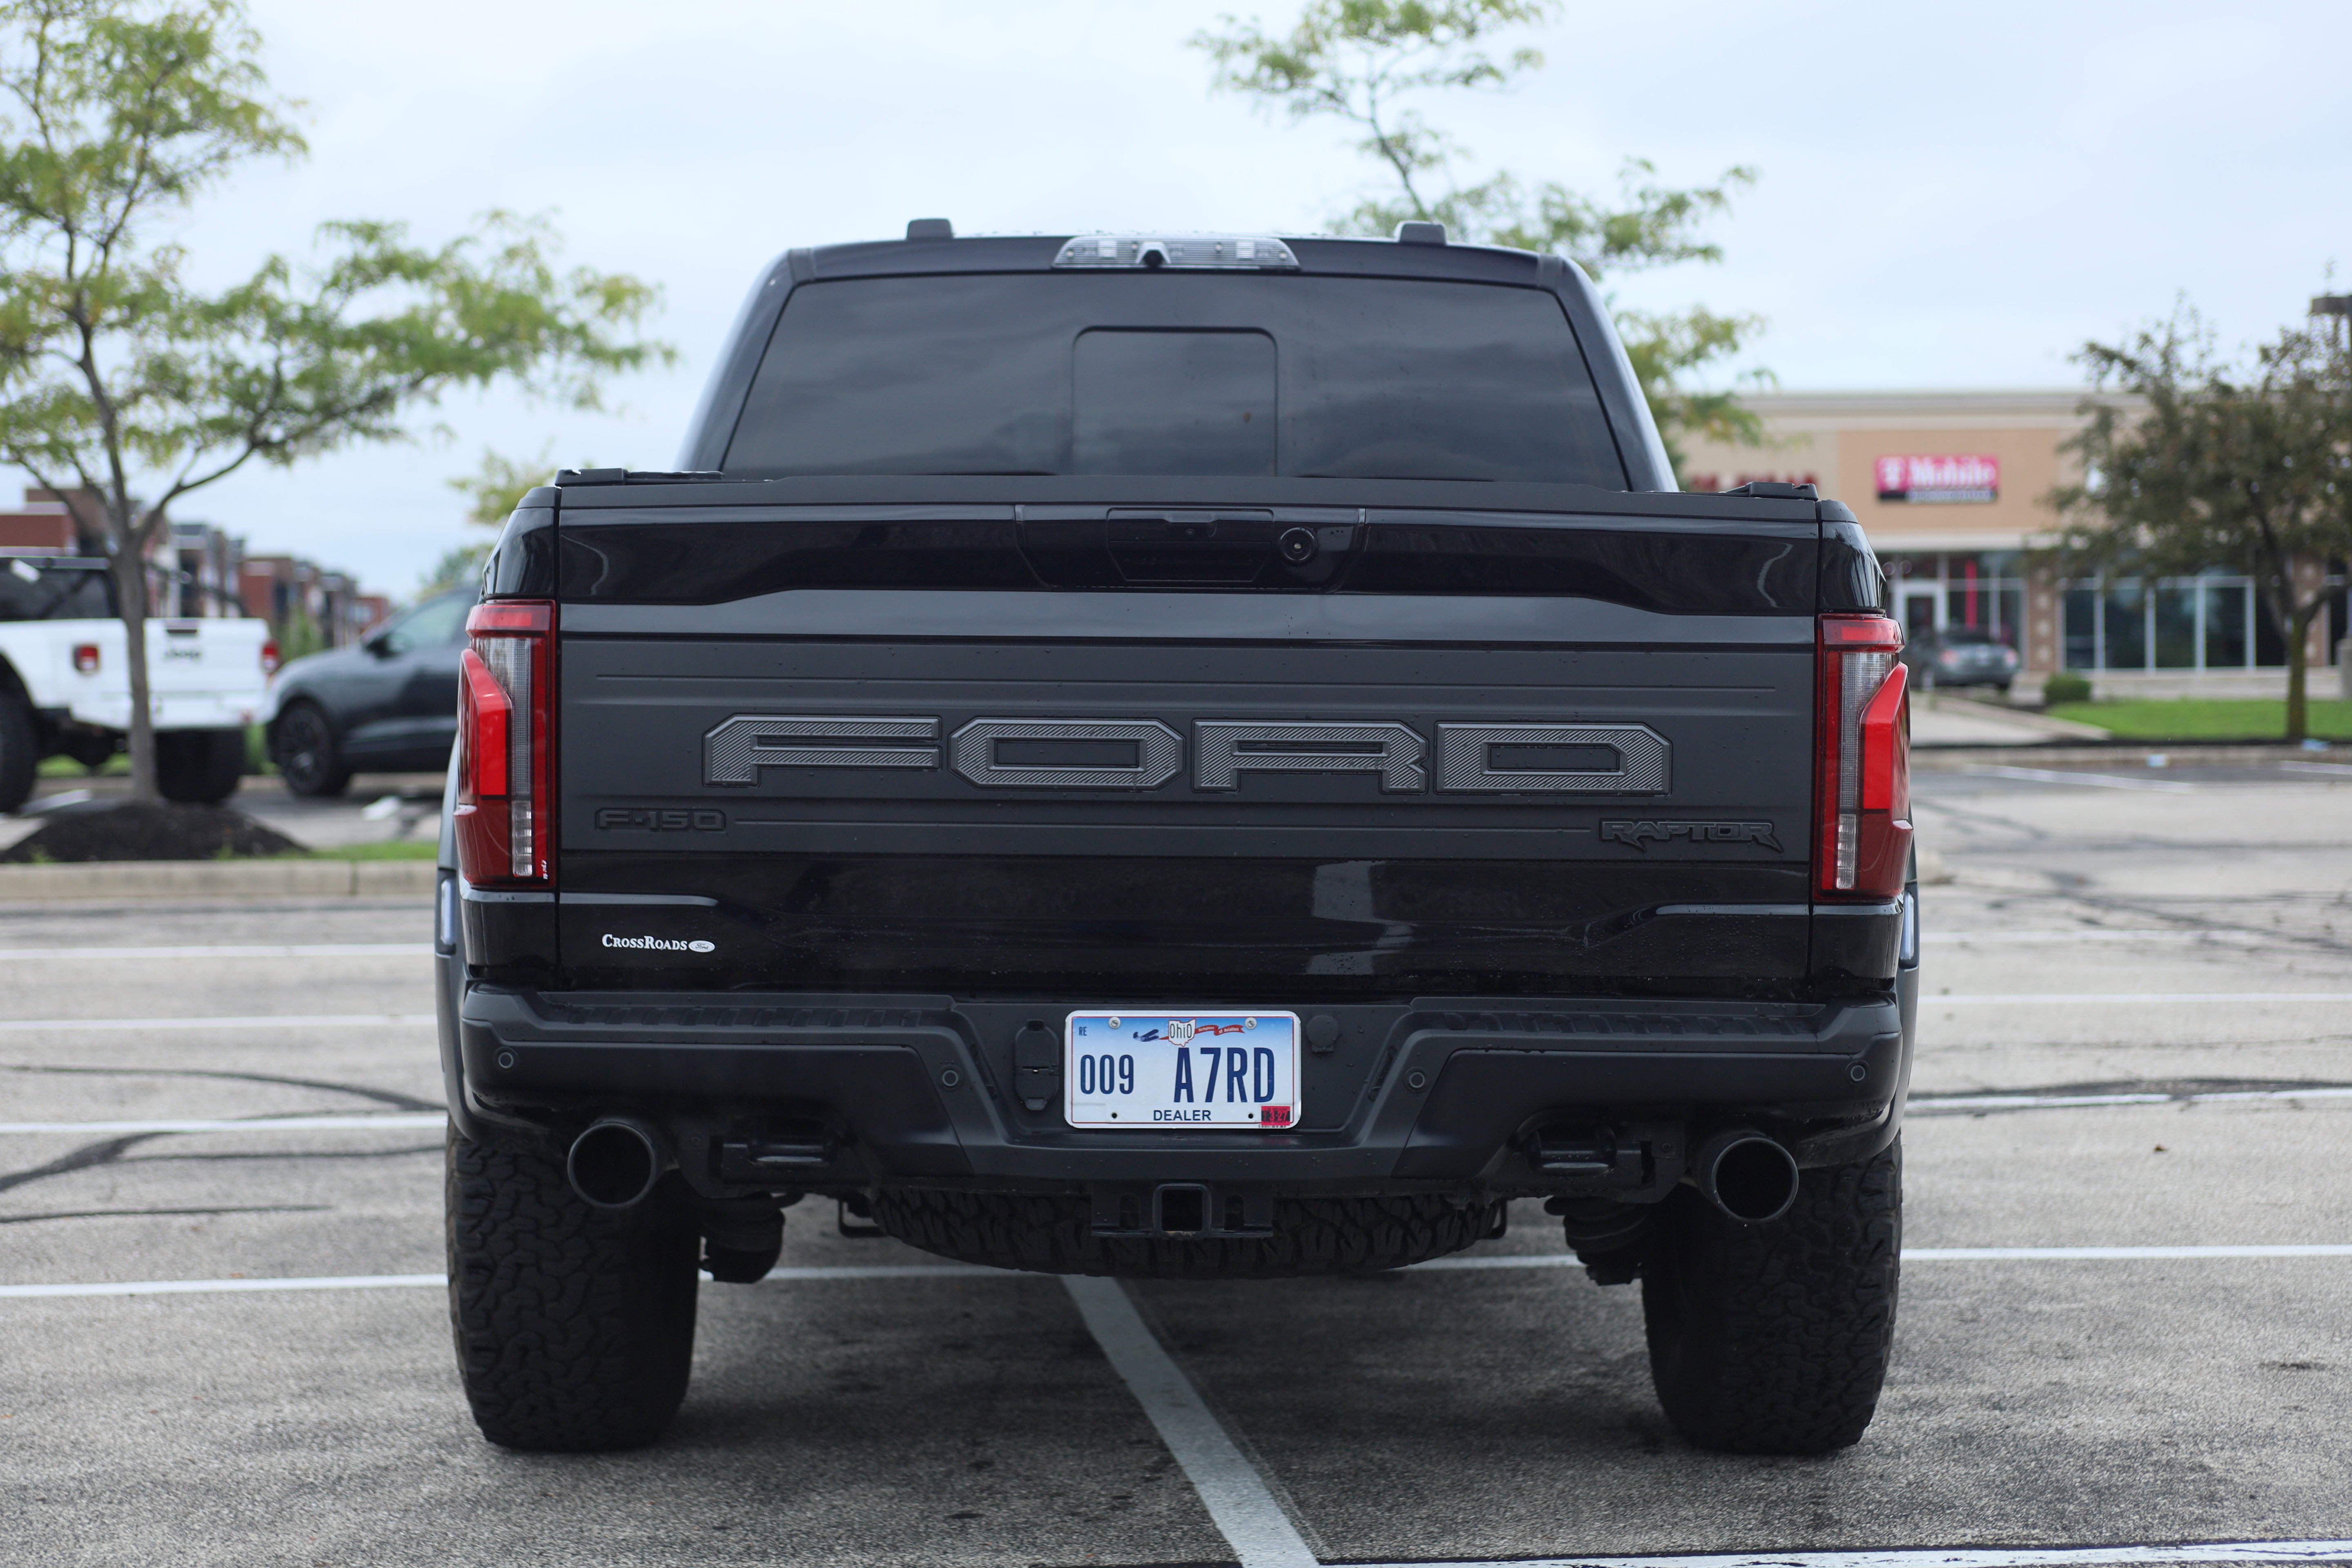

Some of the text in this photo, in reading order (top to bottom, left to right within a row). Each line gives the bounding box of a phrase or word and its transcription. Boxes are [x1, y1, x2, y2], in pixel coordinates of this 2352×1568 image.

[1909, 456, 1997, 486] Mobile
[704, 715, 1671, 794] FORD
[595, 808, 726, 831] F-150
[1600, 819, 1784, 853] RAPTOR
[1078, 1027, 1087, 1036] RE
[1080, 1047, 1275, 1103] 009 A7RD
[1153, 1110, 1212, 1121] DEALER
